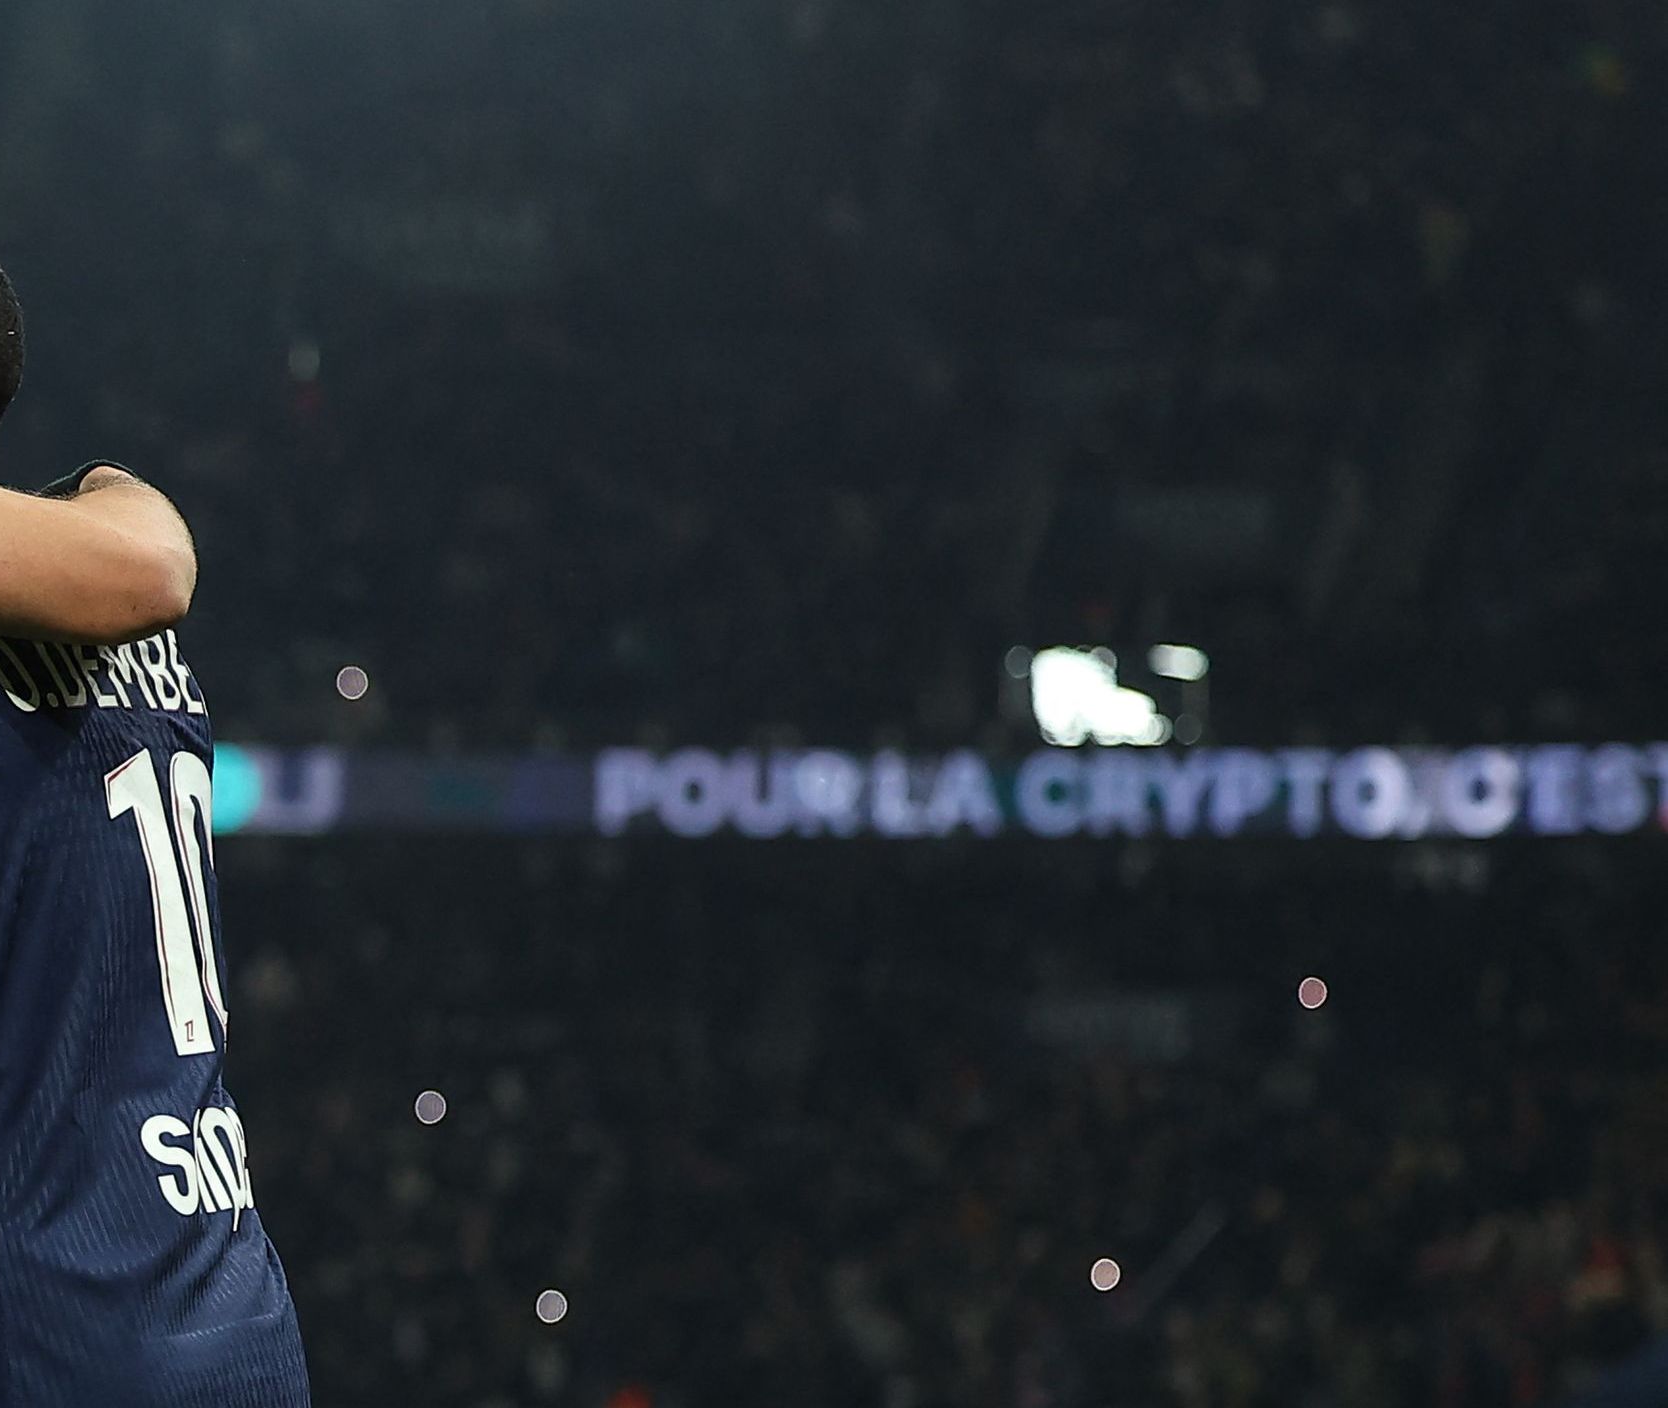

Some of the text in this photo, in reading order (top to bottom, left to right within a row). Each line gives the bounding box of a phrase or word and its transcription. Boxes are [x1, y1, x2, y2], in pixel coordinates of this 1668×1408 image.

[592, 745, 861, 838] POUR
[870, 745, 1003, 838] LA
[103, 747, 229, 1055] 10
